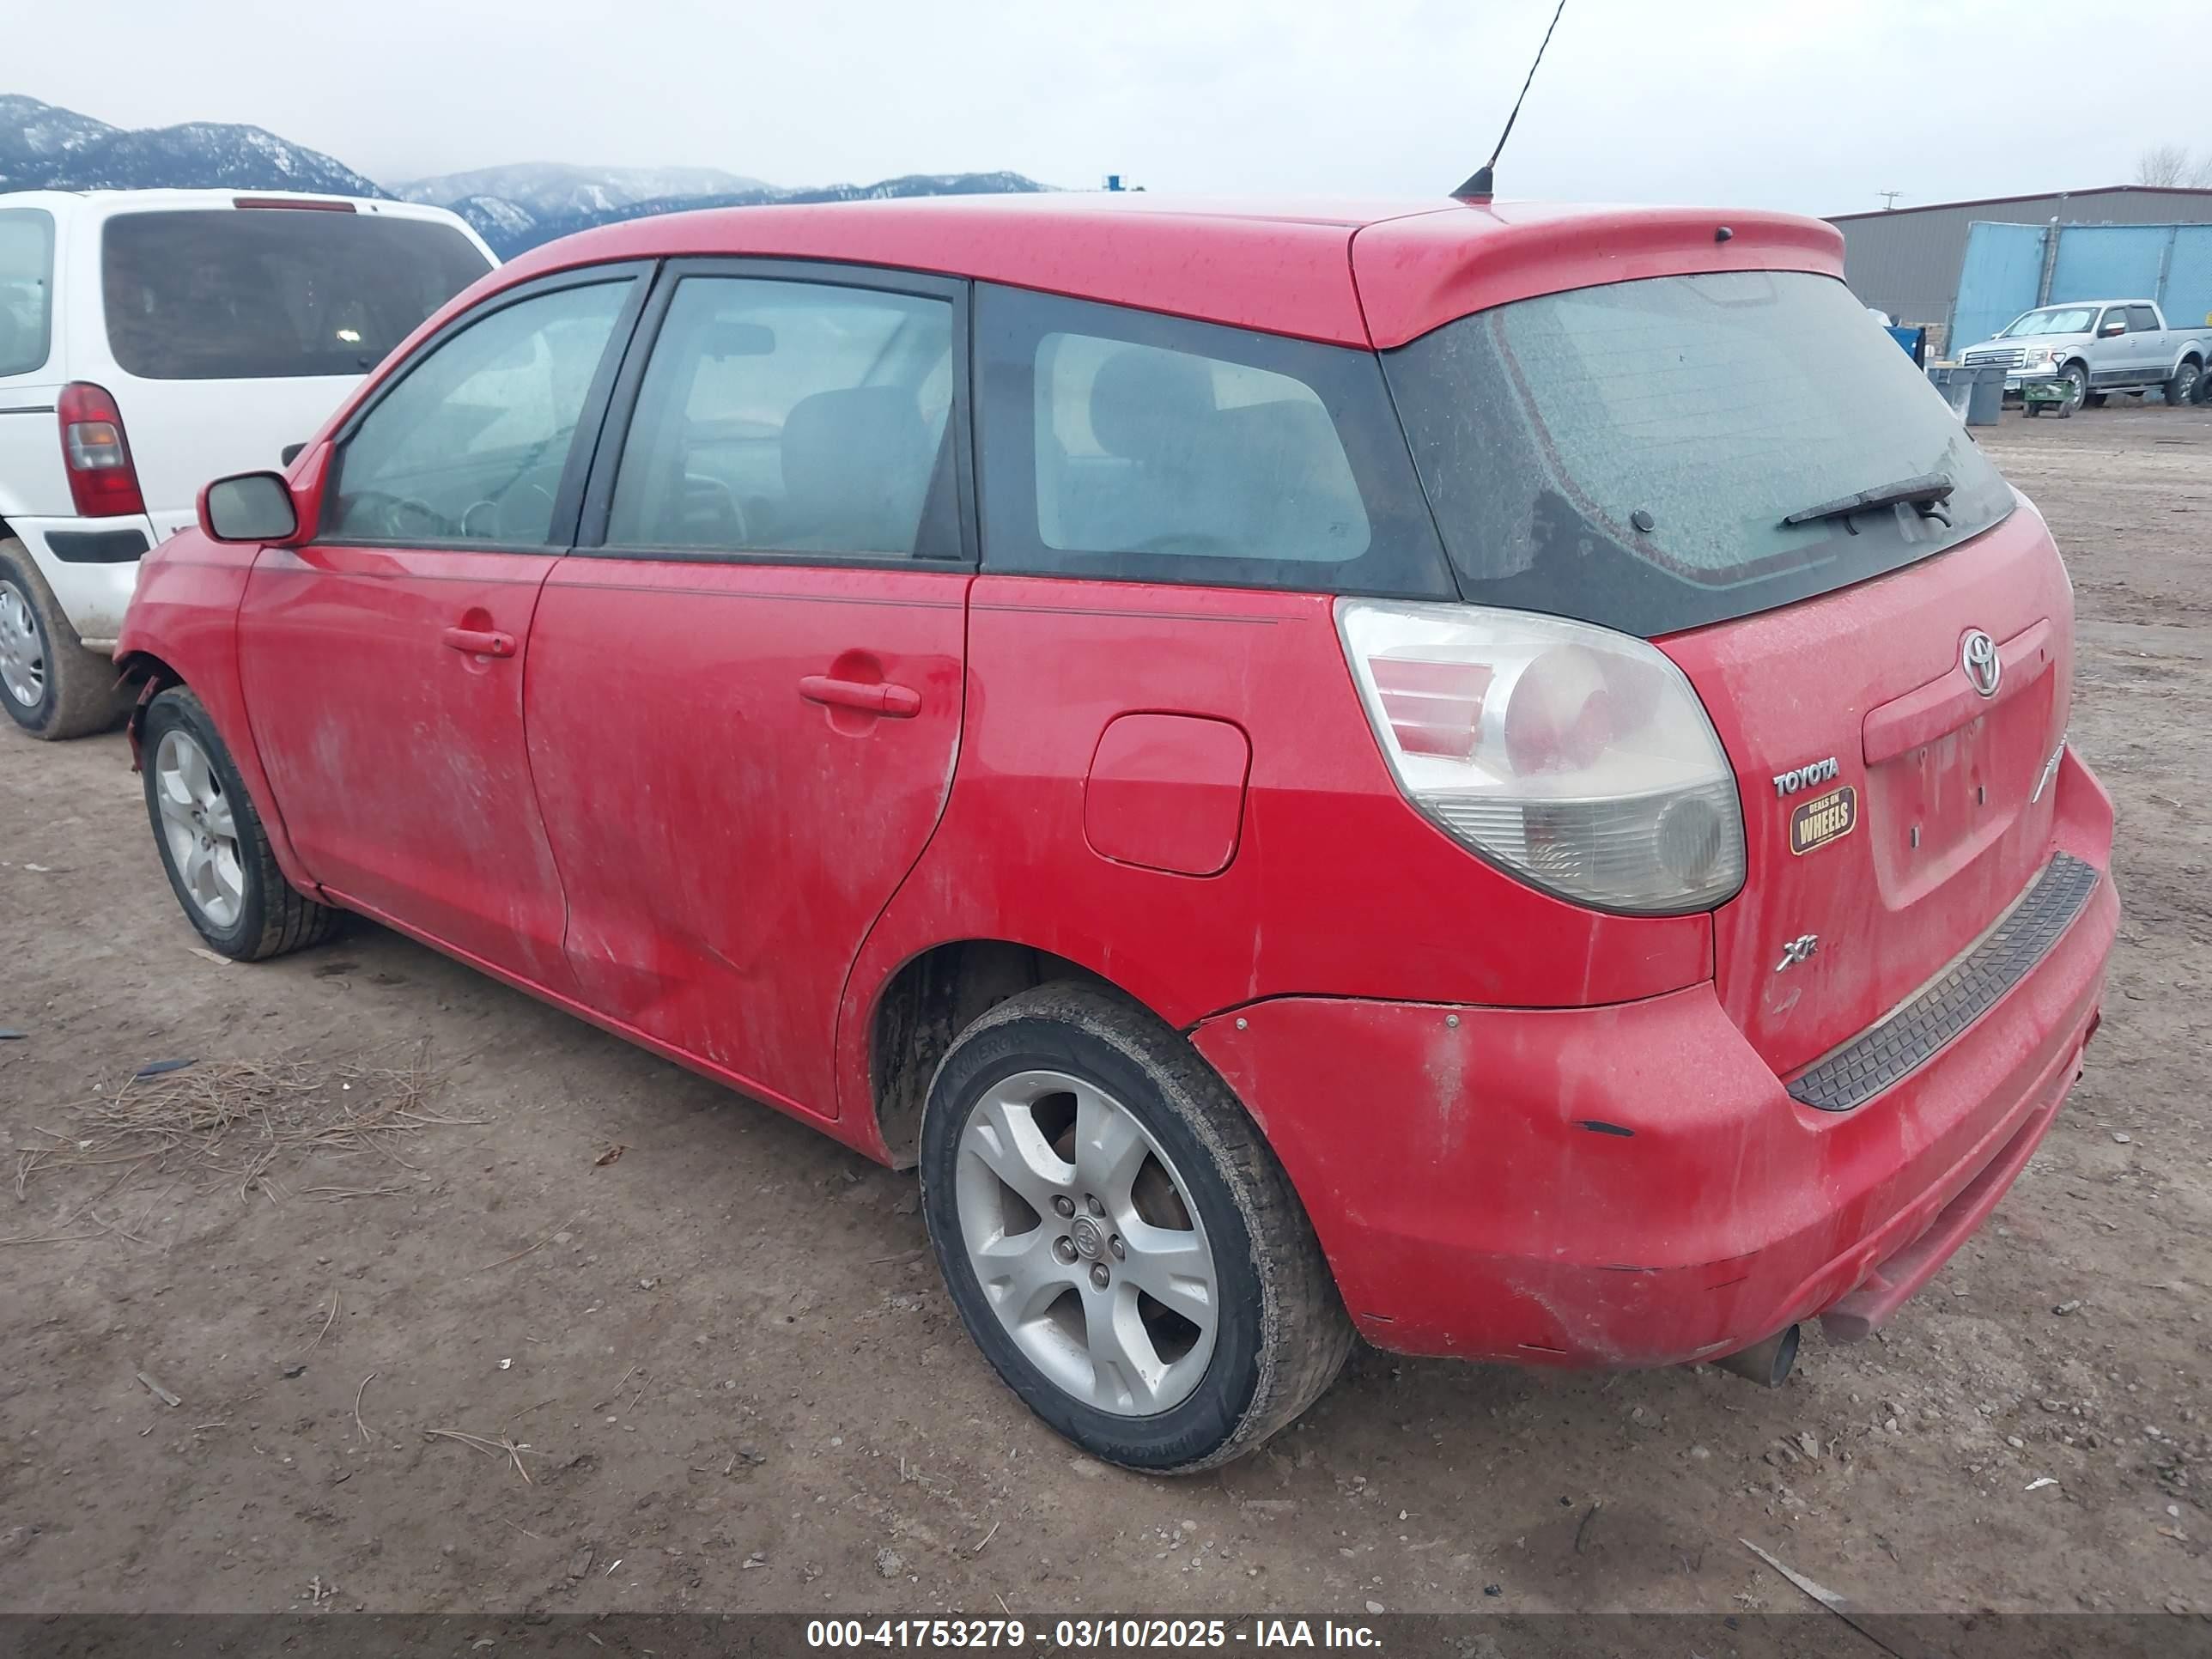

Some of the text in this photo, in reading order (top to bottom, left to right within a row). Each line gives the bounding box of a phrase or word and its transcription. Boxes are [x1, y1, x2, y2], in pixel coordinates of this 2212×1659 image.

[1772, 757, 1839, 798] TOYOTA
[1799, 802, 1848, 845] WHEELS
[1808, 793, 1839, 814] DEALS ON
